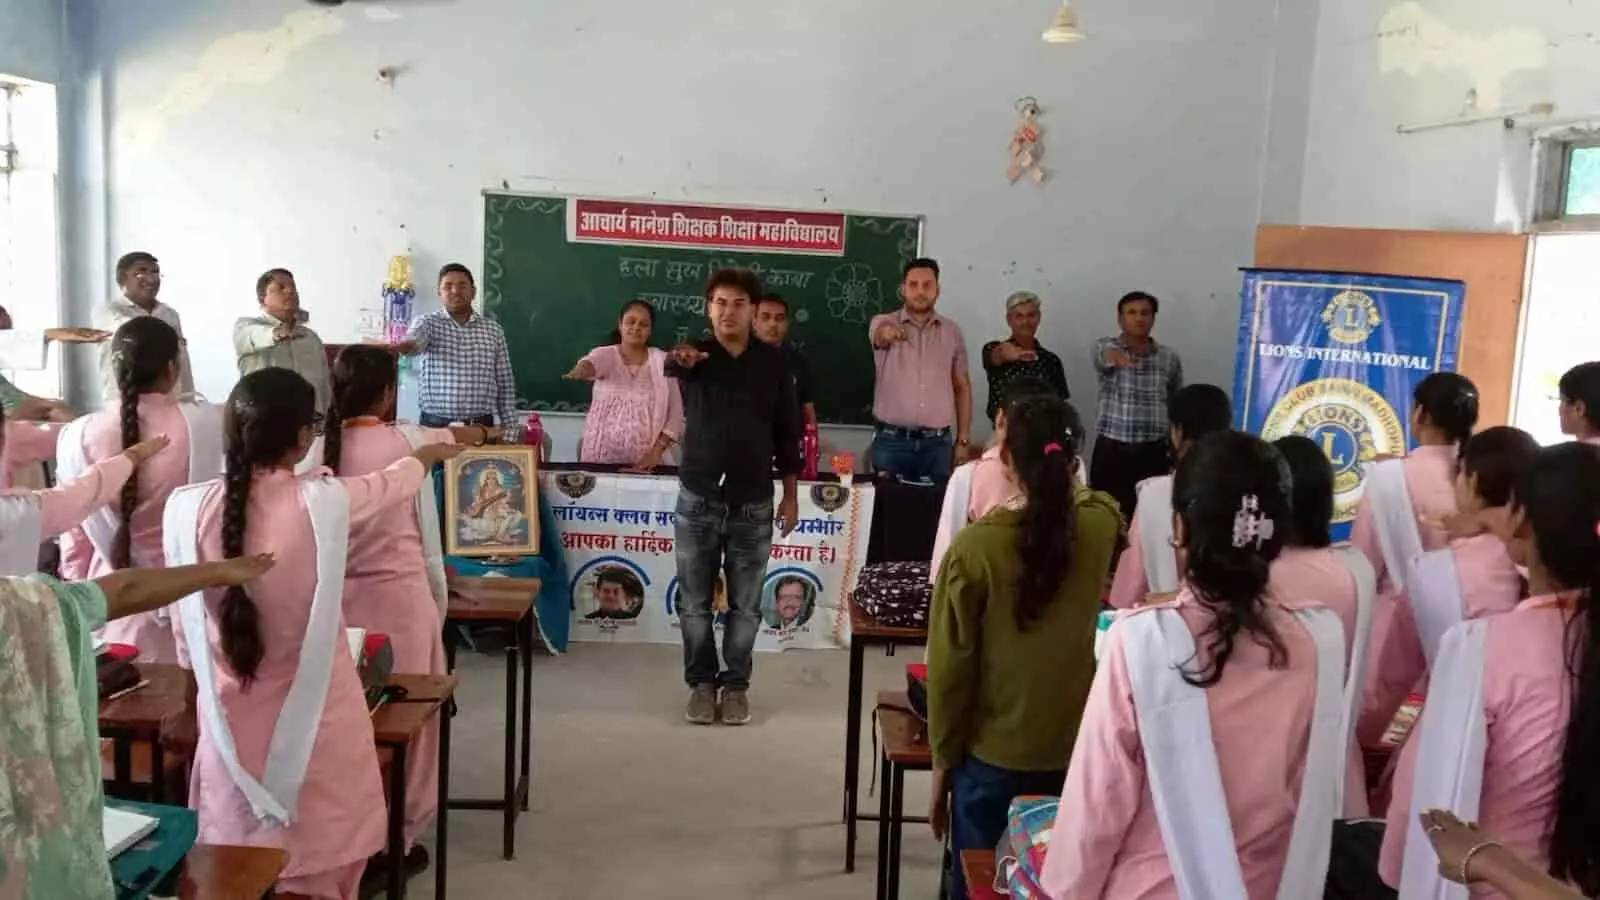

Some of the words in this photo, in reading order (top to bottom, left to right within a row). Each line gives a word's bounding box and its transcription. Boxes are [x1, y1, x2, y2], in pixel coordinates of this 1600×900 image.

[580, 208, 627, 233] आचार्य
[629, 210, 669, 236] नानेश
[671, 212, 718, 239] शिक्षक
[720, 215, 757, 241] शिक्षा
[758, 218, 841, 245] महाविद्यालय
[1259, 343, 1305, 359] LIONS
[1307, 346, 1431, 370] INTERNATIONAL
[1322, 432, 1345, 465] L
[613, 509, 650, 526] क्लब
[560, 531, 617, 550] आपका
[623, 530, 674, 556] हार्दिक
[768, 543, 813, 562] करता
